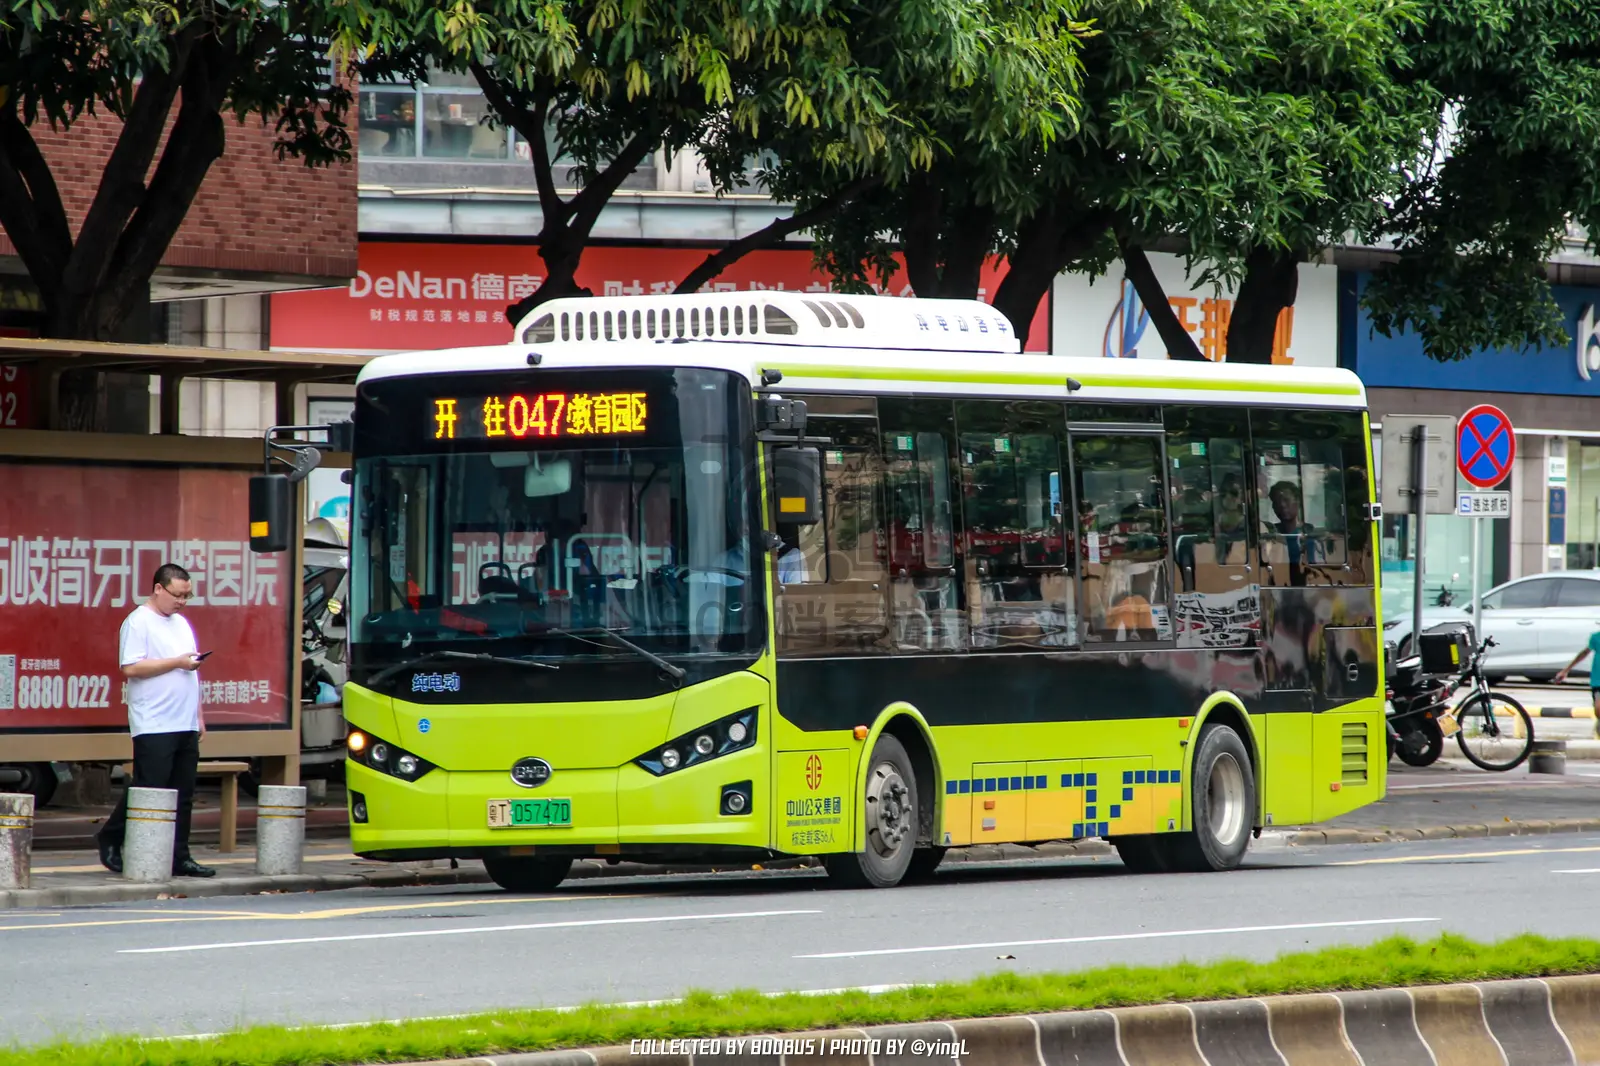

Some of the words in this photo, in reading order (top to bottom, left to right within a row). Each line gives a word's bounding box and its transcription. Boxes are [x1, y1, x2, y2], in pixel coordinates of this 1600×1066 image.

[349, 270, 467, 299] DeNan
[471, 273, 543, 300] 德南
[370, 308, 507, 323] 财税规范落地服务
[18, 675, 63, 709] 8880
[67, 675, 110, 709] 0222
[411, 671, 461, 692] 纯电动
